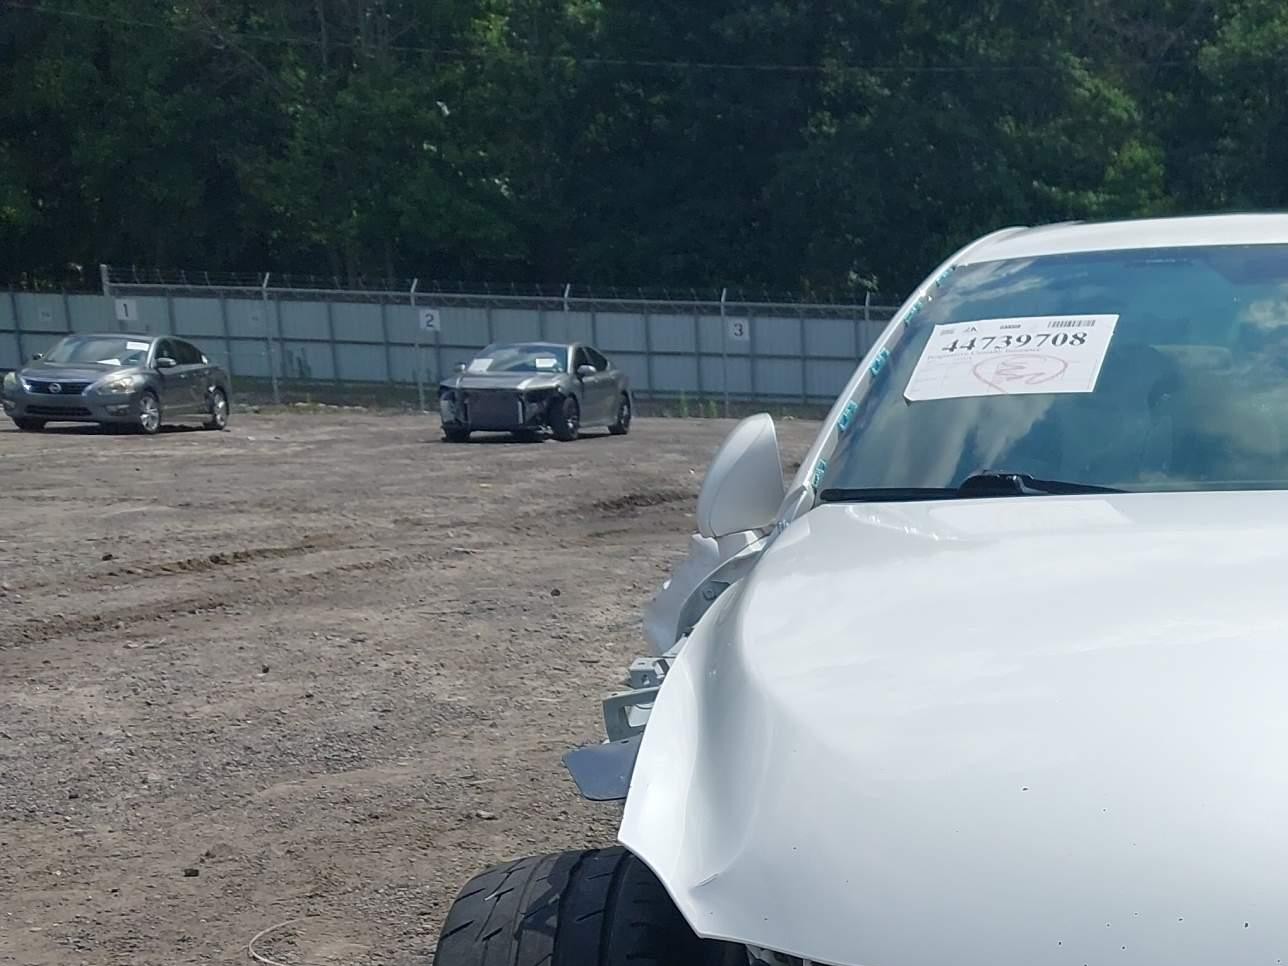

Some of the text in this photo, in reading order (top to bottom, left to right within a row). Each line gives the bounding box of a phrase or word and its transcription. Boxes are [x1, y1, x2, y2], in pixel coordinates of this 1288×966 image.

[425, 313, 434, 328] 2
[734, 322, 744, 337] 3
[942, 331, 1088, 353] 44739708
